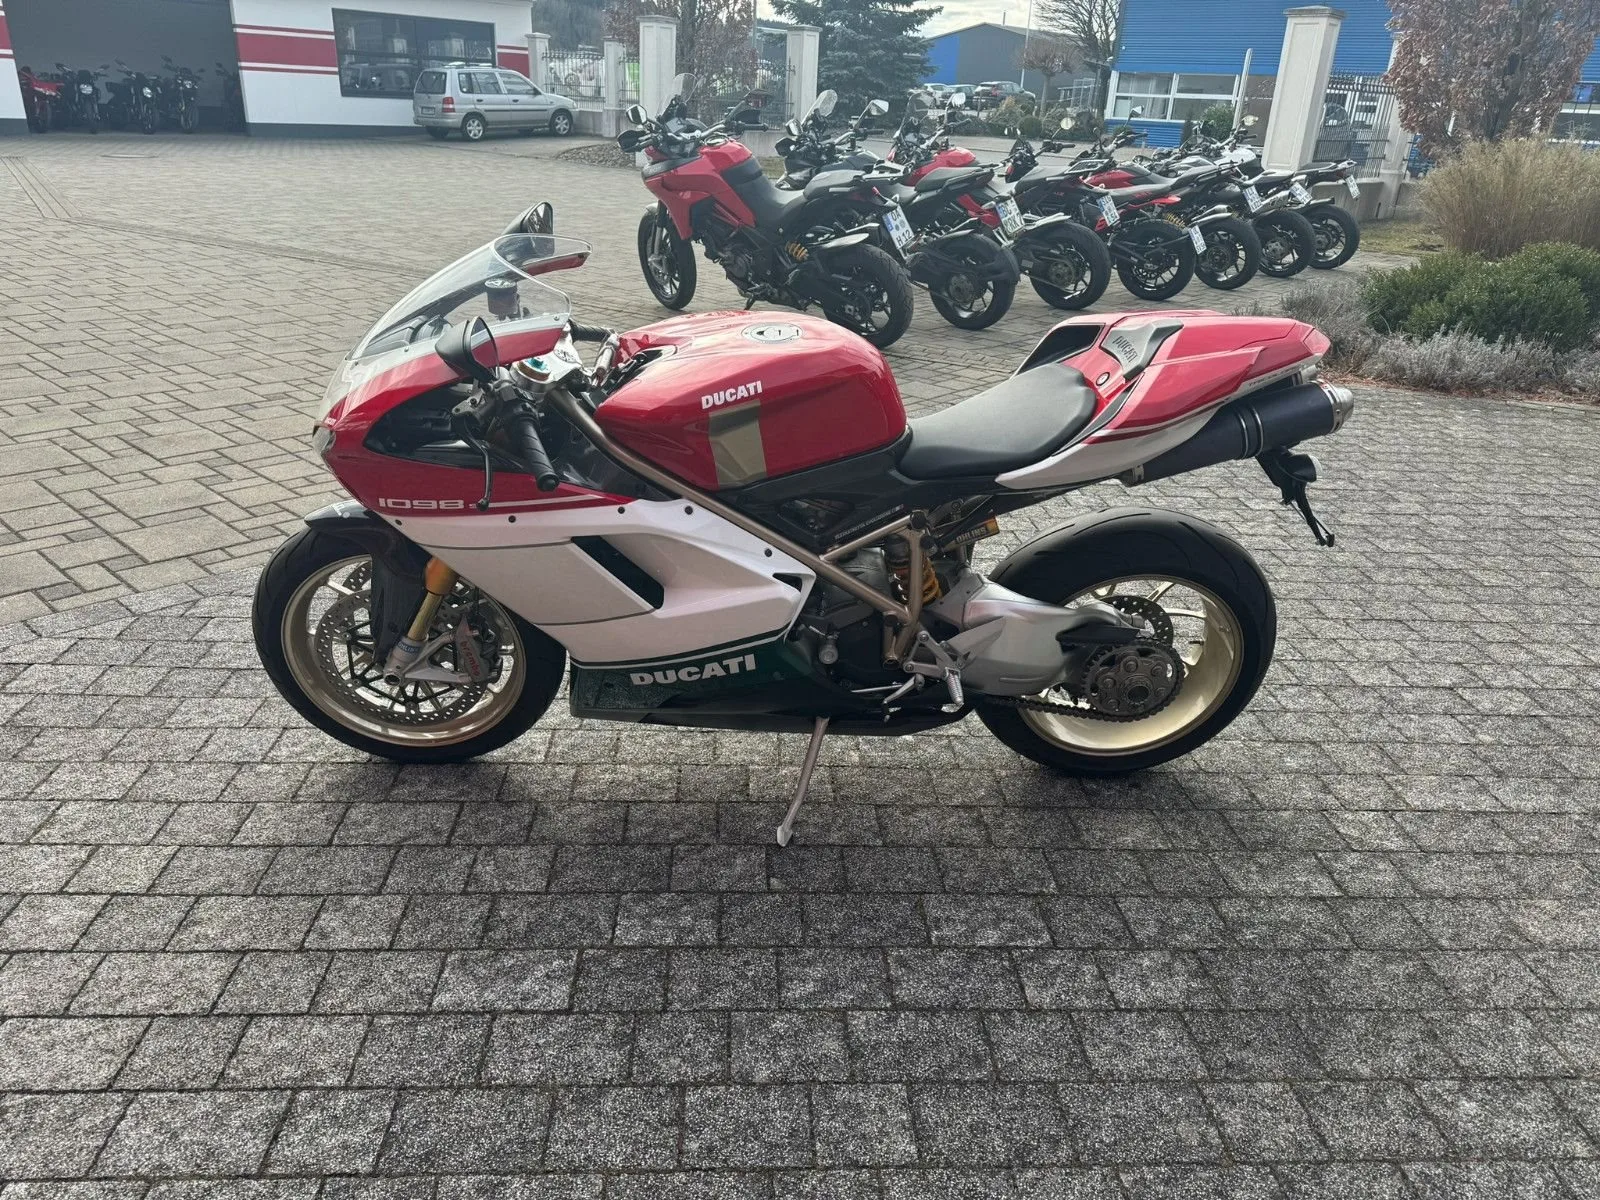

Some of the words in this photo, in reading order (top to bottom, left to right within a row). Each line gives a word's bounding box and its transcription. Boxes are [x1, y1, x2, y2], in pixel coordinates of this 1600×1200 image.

[1112, 335, 1138, 363] DUCATI
[701, 380, 763, 410] DUCATI
[378, 497, 465, 510] 1098
[460, 640, 481, 676] brembo
[629, 653, 757, 687] DUCATI
